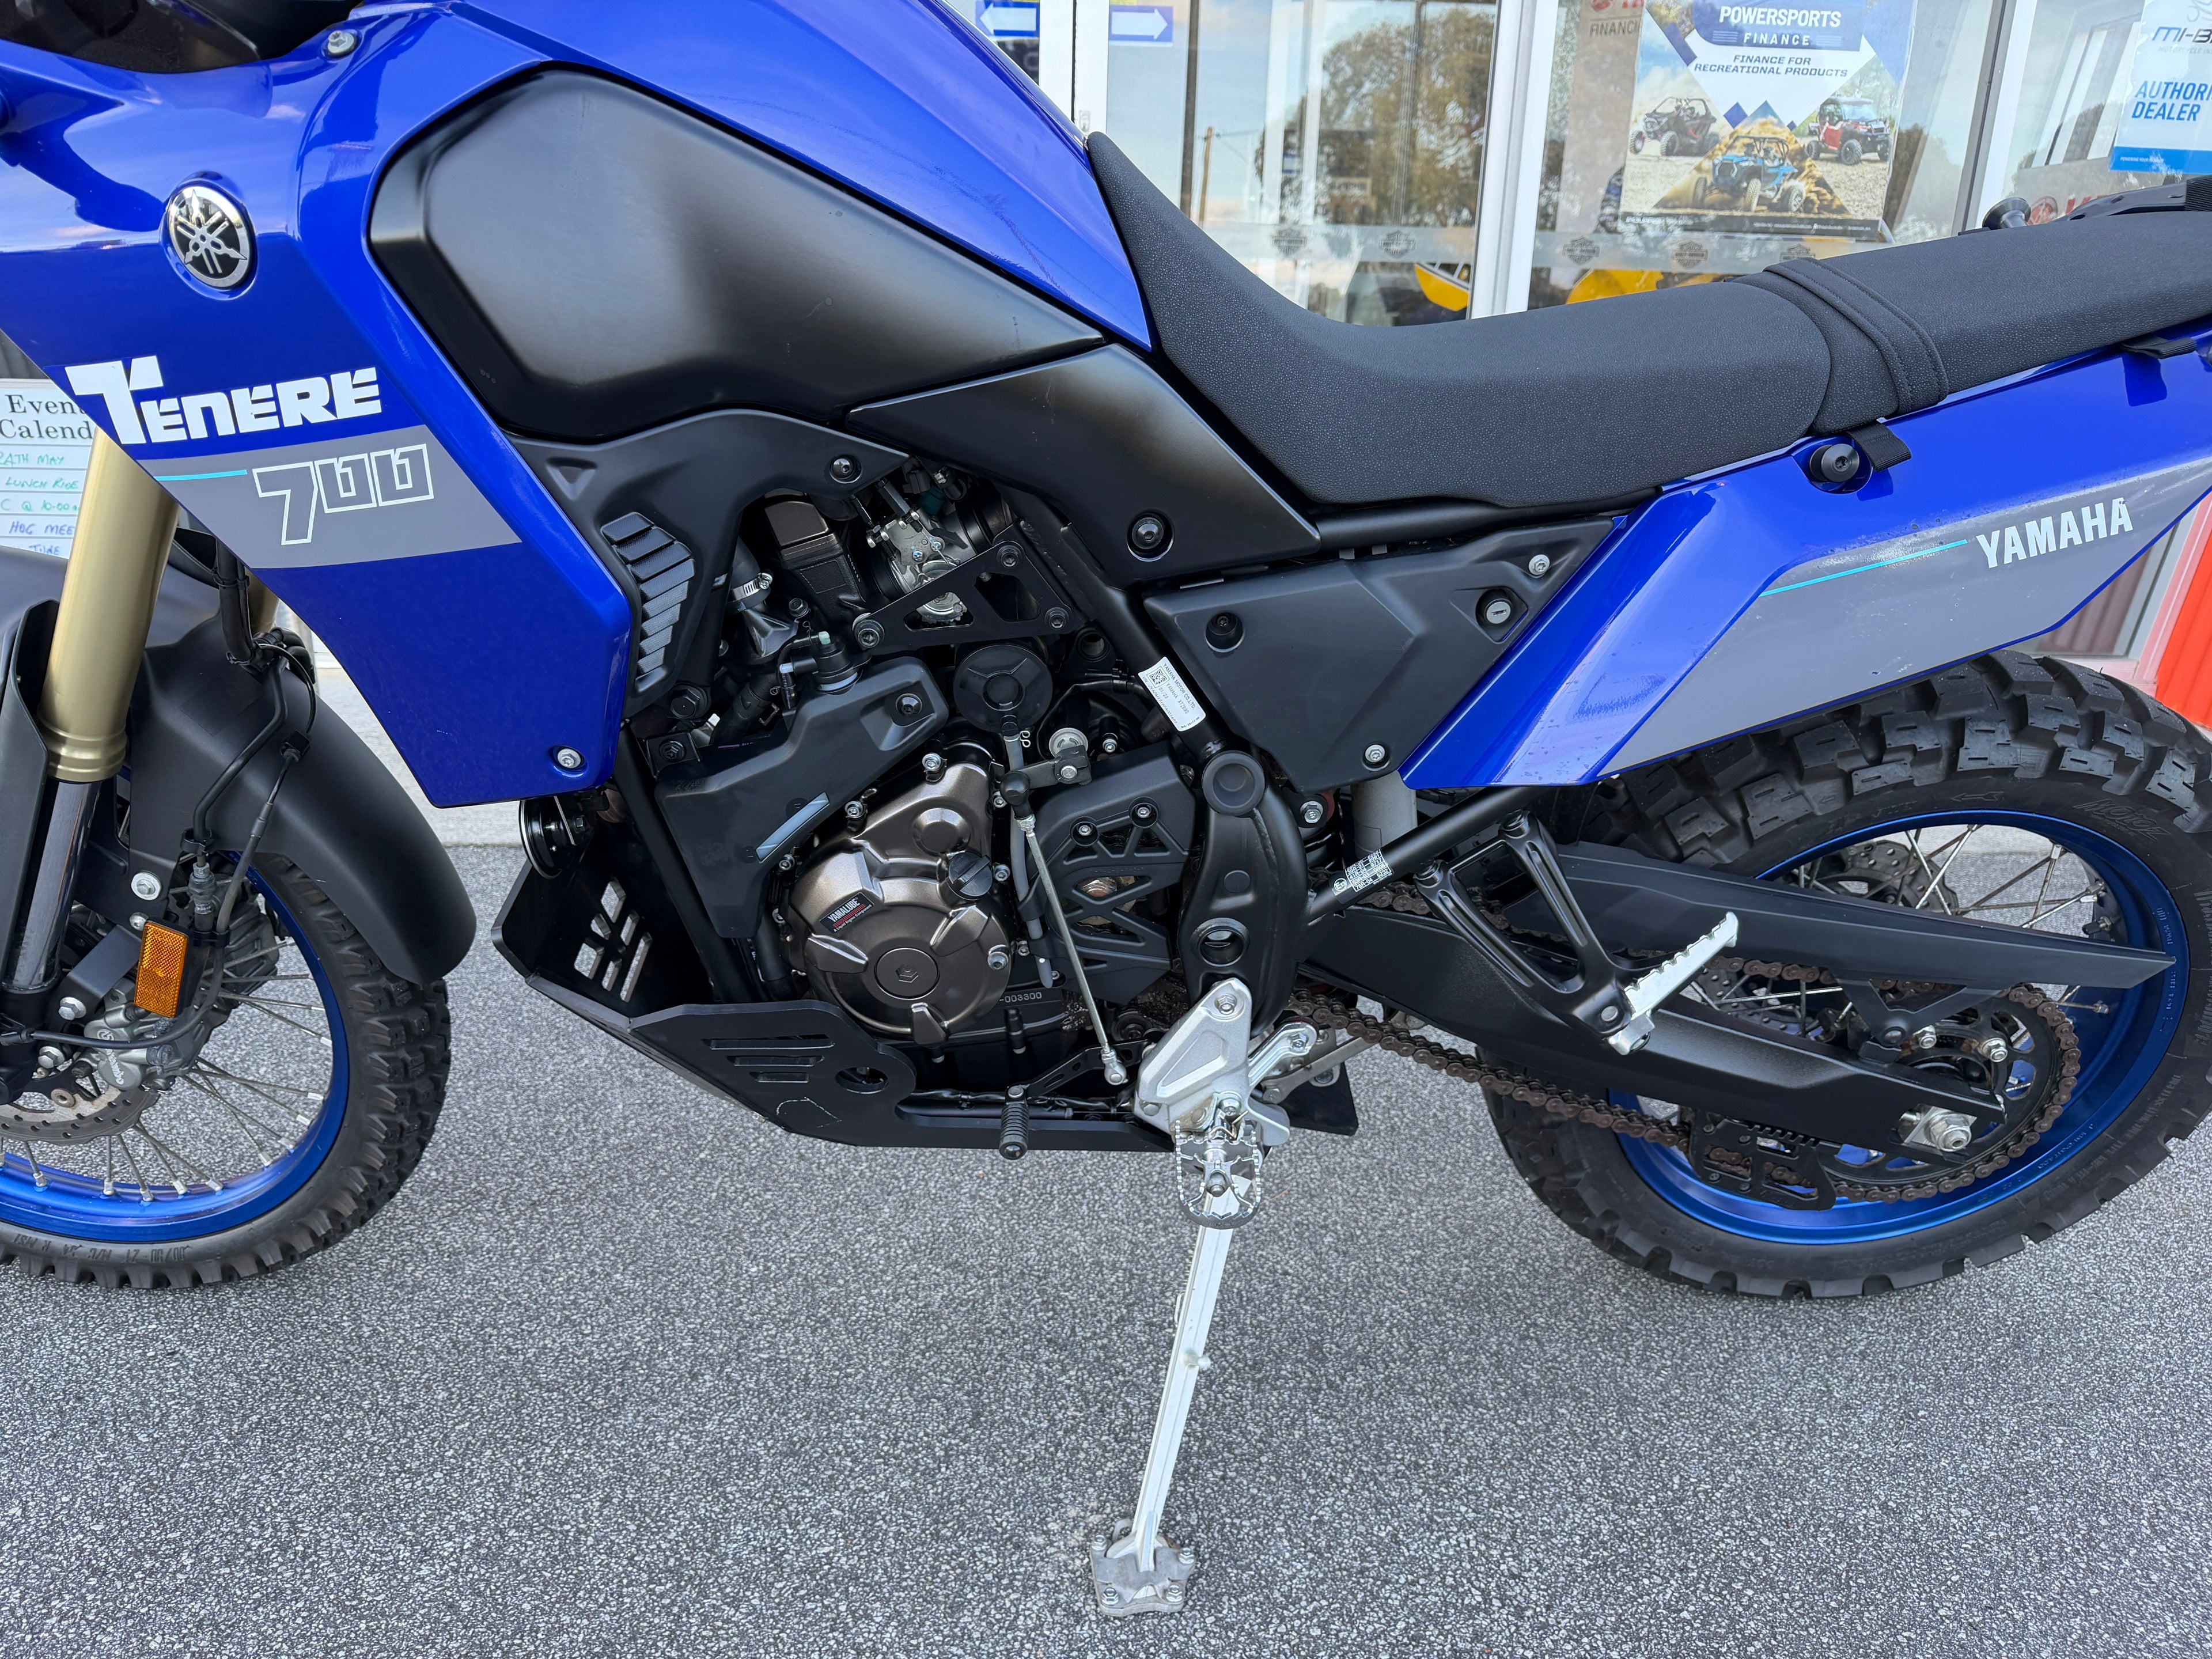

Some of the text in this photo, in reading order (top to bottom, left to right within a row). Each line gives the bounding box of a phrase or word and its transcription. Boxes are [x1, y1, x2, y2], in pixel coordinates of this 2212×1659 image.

[1719, 6, 1842, 28] POWERSPORTS
[1743, 32, 1810, 46] FINANCE
[2152, 26, 2212, 43] MI-B
[1733, 54, 1811, 65] FINANCE FOR
[1694, 63, 1848, 77] RECREATIONAL PRODUCTS
[2135, 80, 2212, 101] AUTHORI
[2131, 101, 2201, 122] DEALER
[0, 419, 93, 439] Calend
[5, 476, 48, 488] LUNCH
[252, 443, 434, 546] 700
[9, 521, 75, 535] HOG MEE
[1976, 497, 2134, 569] YAMAHA
[1162, 662, 1176, 681] YAMAHA
[1174, 679, 1185, 695] MOTOR
[1165, 682, 1179, 699] YAMAHA
[1349, 867, 1367, 880] 41R-04
[1370, 858, 1382, 868] 9717
[1355, 877, 1373, 891] 78R-04
[1377, 868, 1389, 878] 5232
